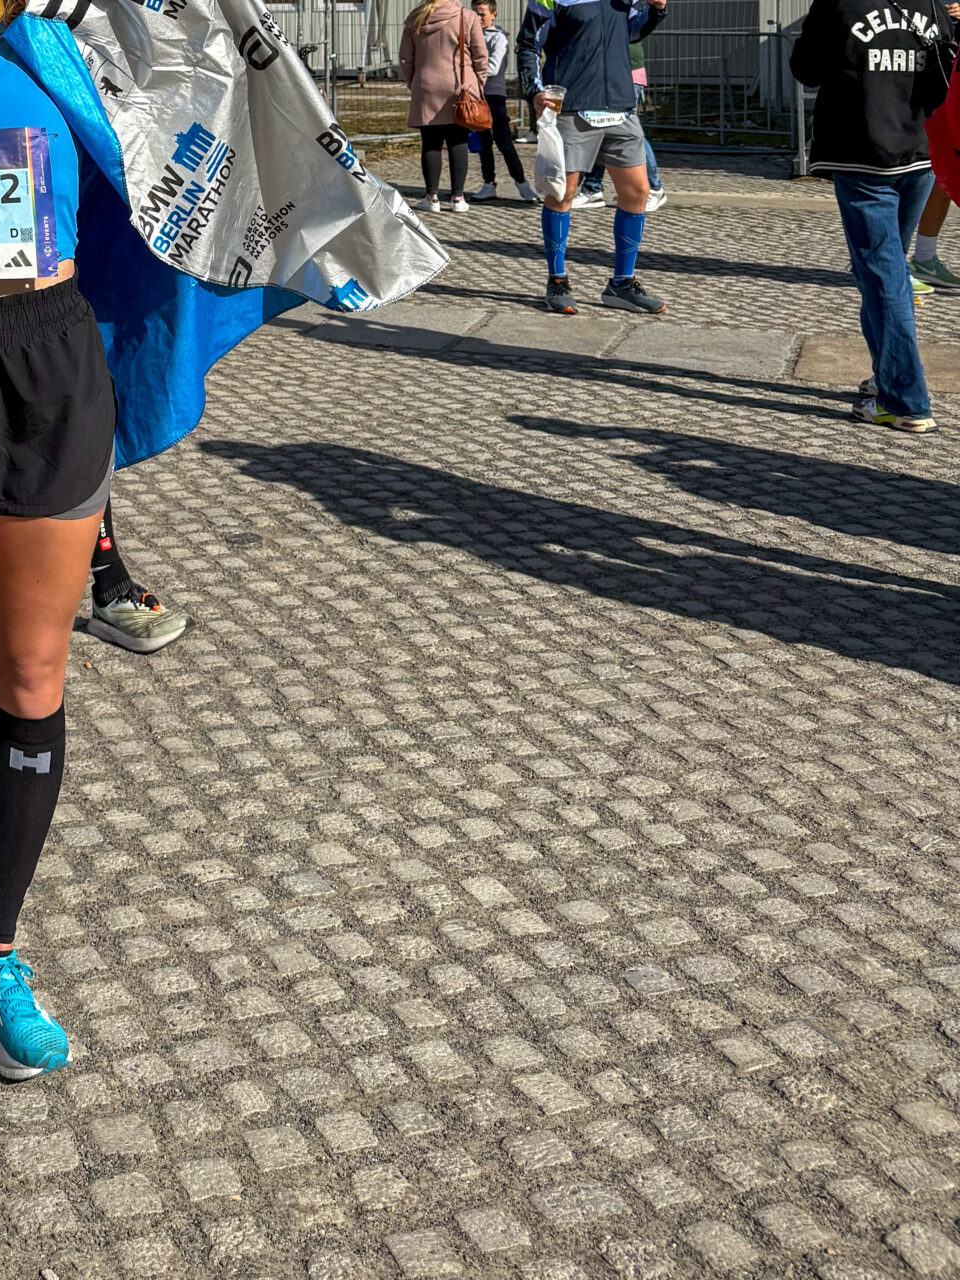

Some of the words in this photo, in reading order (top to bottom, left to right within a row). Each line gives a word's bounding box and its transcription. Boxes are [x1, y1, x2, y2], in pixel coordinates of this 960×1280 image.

[868, 49, 927, 72] PARIS
[153, 180, 206, 254] BERLIN
[168, 148, 236, 266] MARATHON
[10, 228, 19, 239] D
[245, 213, 268, 251] WORLD
[250, 201, 296, 256] MARATHON
[254, 220, 289, 260] MAJORS
